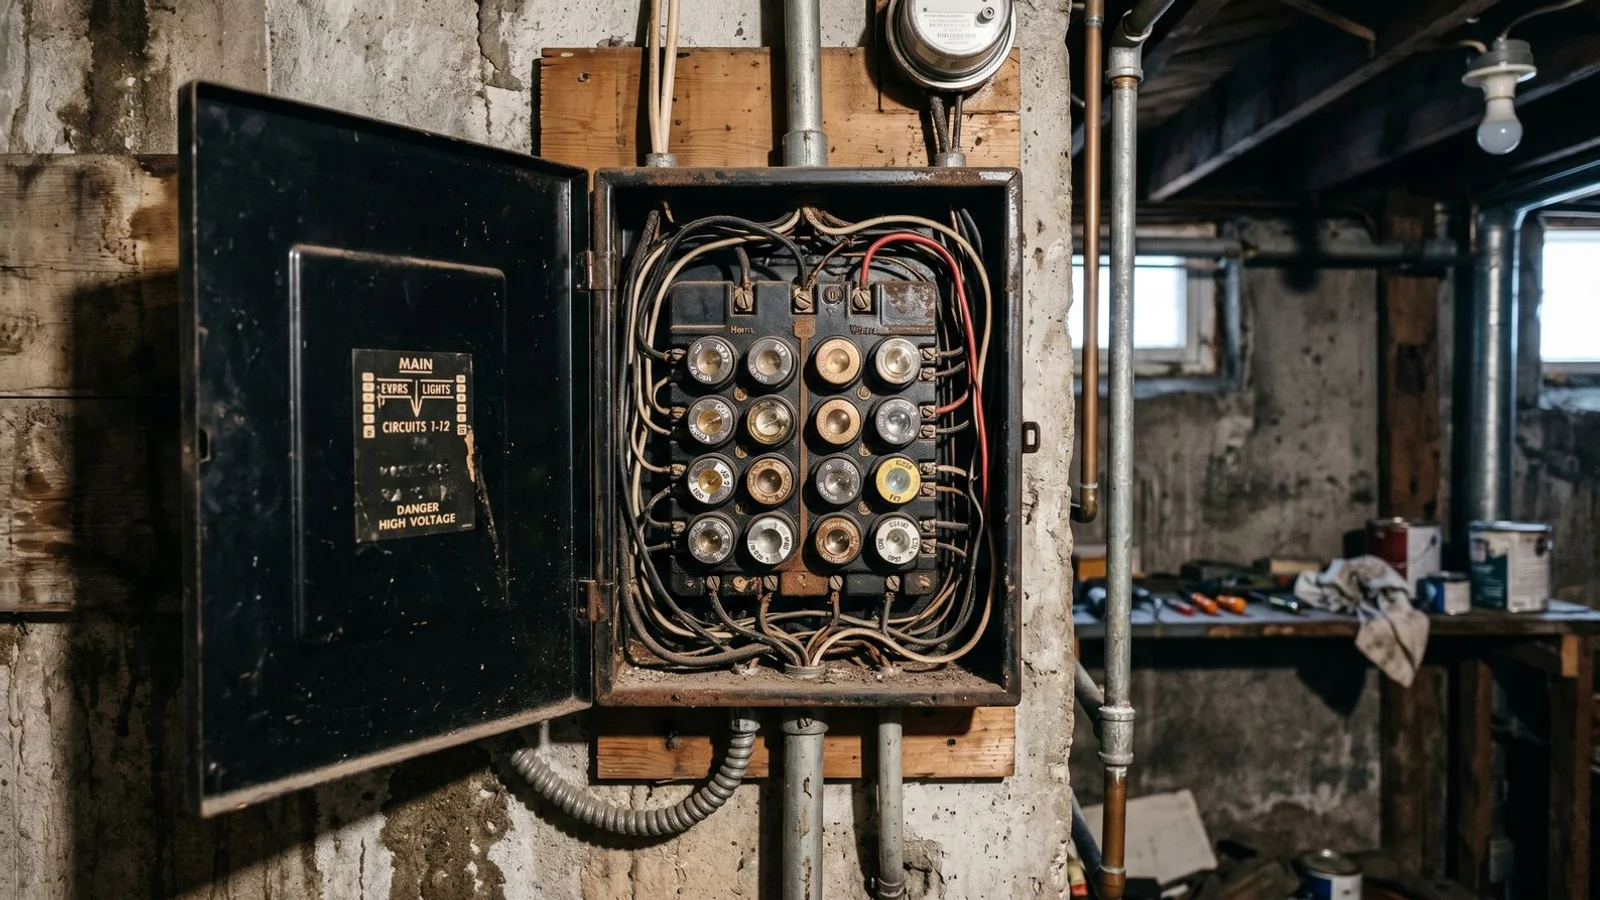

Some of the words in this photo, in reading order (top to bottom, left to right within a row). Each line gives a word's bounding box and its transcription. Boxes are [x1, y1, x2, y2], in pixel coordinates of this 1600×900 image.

[399, 357, 433, 370] MAIN
[422, 384, 451, 394] LIGHTS
[382, 421, 427, 433] CIRCUITS
[396, 502, 440, 516] DANGER
[378, 518, 406, 531] HIGH
[409, 513, 456, 527] VOLTAGE
